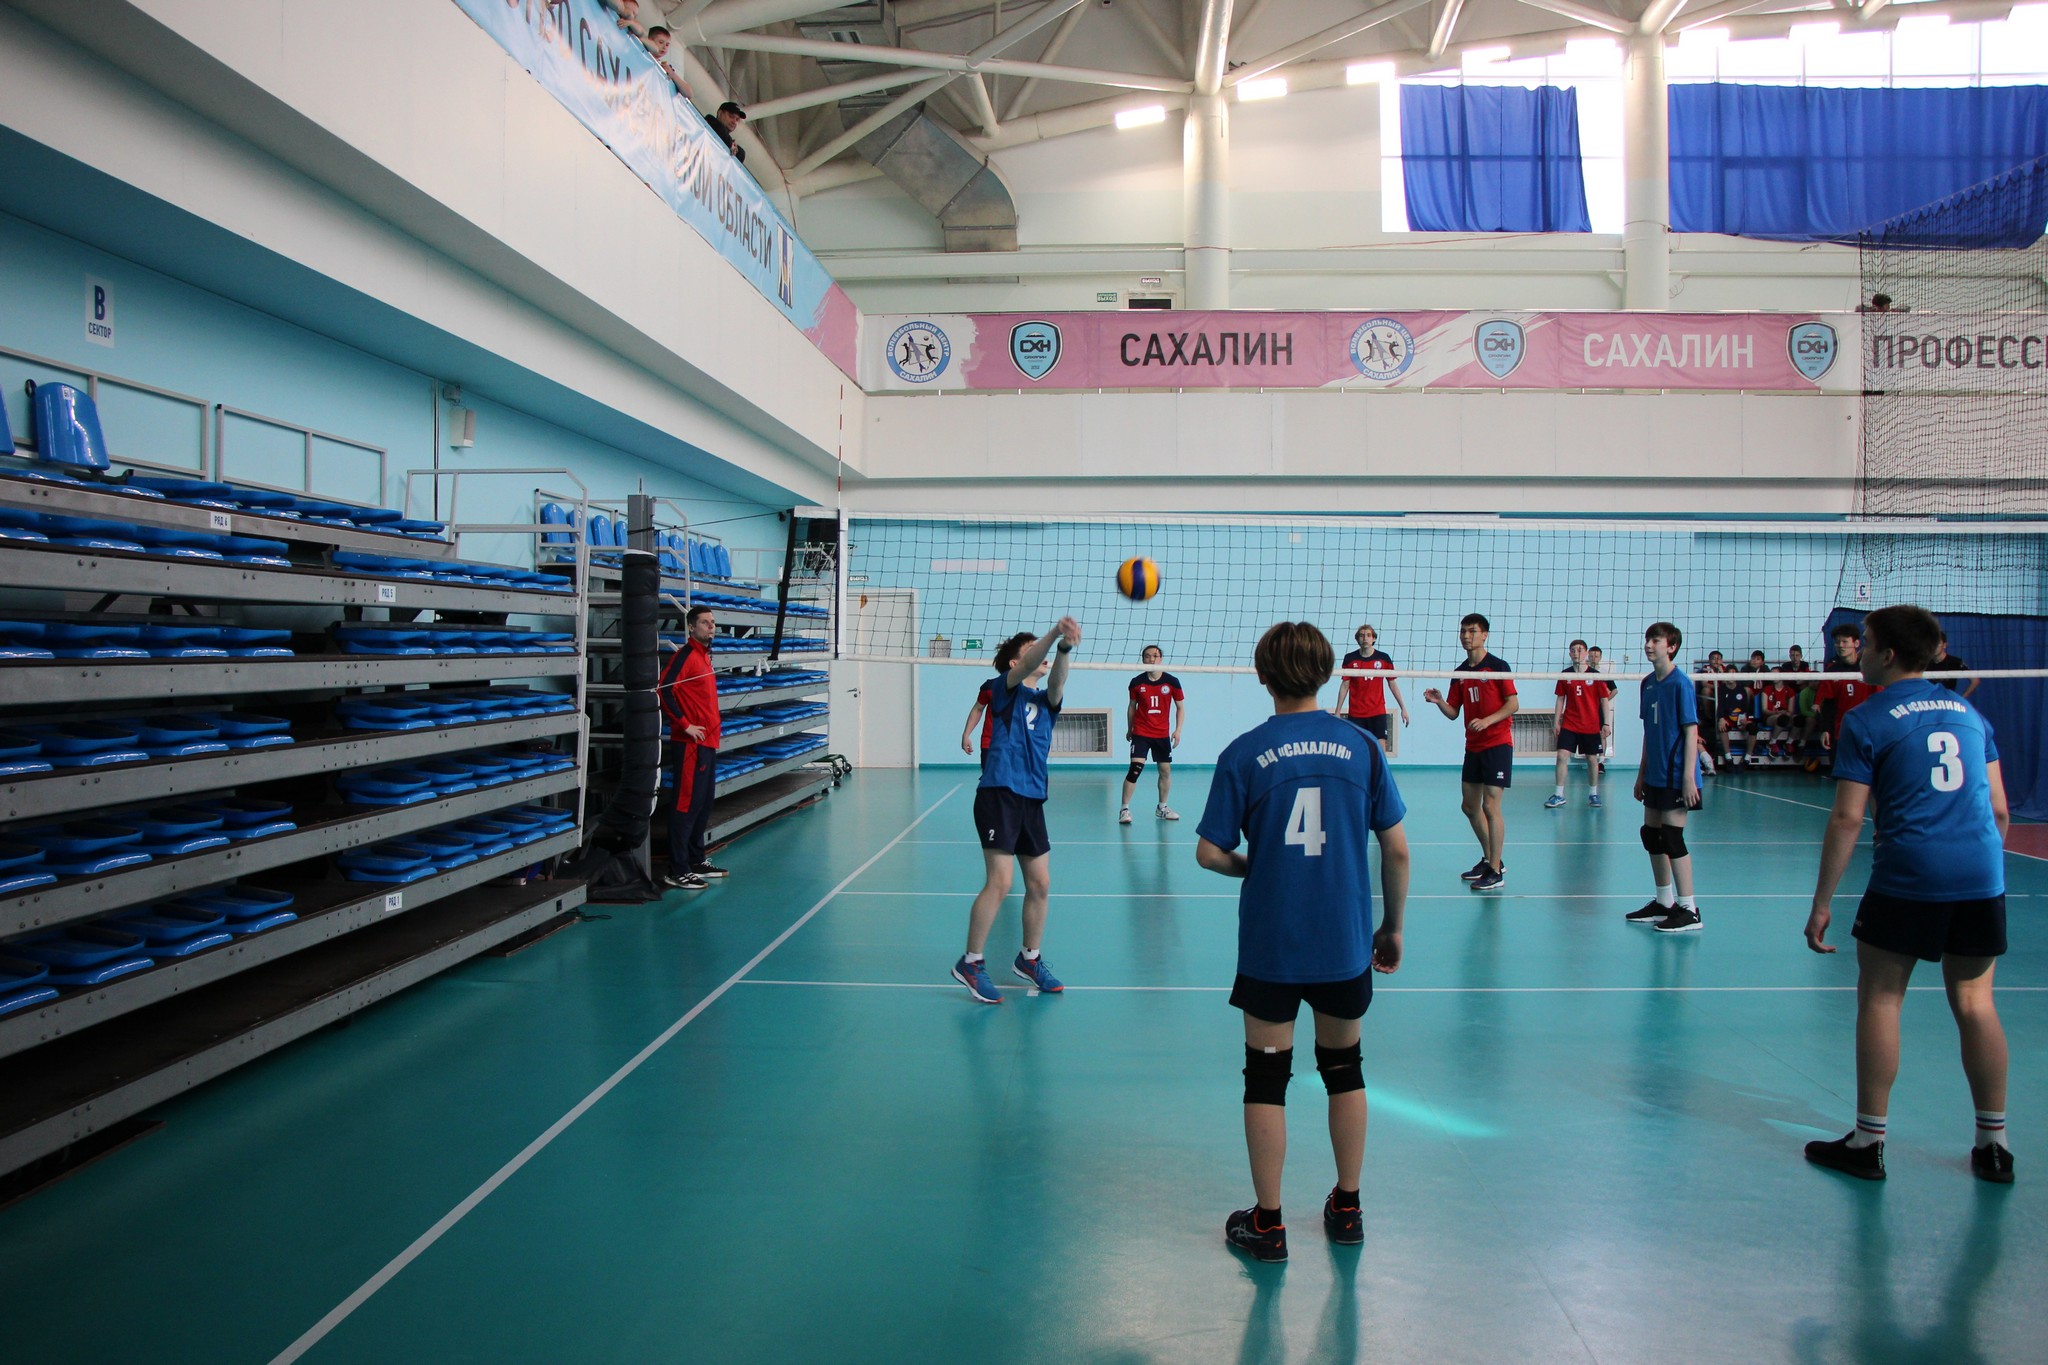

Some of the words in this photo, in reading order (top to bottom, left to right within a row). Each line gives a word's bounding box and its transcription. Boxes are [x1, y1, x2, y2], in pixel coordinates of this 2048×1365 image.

[717, 173, 773, 274] ОБЛАСТИ
[94, 284, 105, 321] В
[88, 321, 112, 339] СЕКТОР
[887, 322, 938, 357] ВОЛЕЙБОЛЬНЫЙ
[936, 328, 950, 358] ЦЕНТР
[1350, 319, 1402, 356] ВОЛЕЙБОЛЬНЫЙ
[1400, 327, 1414, 355] ЦЕНТР
[1120, 332, 1293, 367] САХАЛИН
[1583, 332, 1755, 369] САХАЛИН
[1872, 334, 2048, 369] ПРОФЕСС
[899, 370, 938, 383] САХАЛИН
[1363, 368, 1402, 381] САХАЛИН
[214, 515, 224, 527] РЯД
[381, 587, 390, 598] РЯД
[1150, 695, 1159, 708] 11
[1468, 686, 1480, 703] 10
[1576, 685, 1582, 696] 5
[1846, 683, 1854, 696] 9
[1025, 702, 1038, 731] 2
[1651, 701, 1658, 725] 1
[1889, 703, 1910, 719] ВЦ
[1906, 699, 1966, 713] «САХАЛИН»
[1256, 748, 1279, 769] ВЦ
[1278, 741, 1352, 760] «САХАЛИН»
[1927, 731, 1964, 792] 3
[1285, 787, 1327, 857] 4
[988, 828, 996, 841] 2
